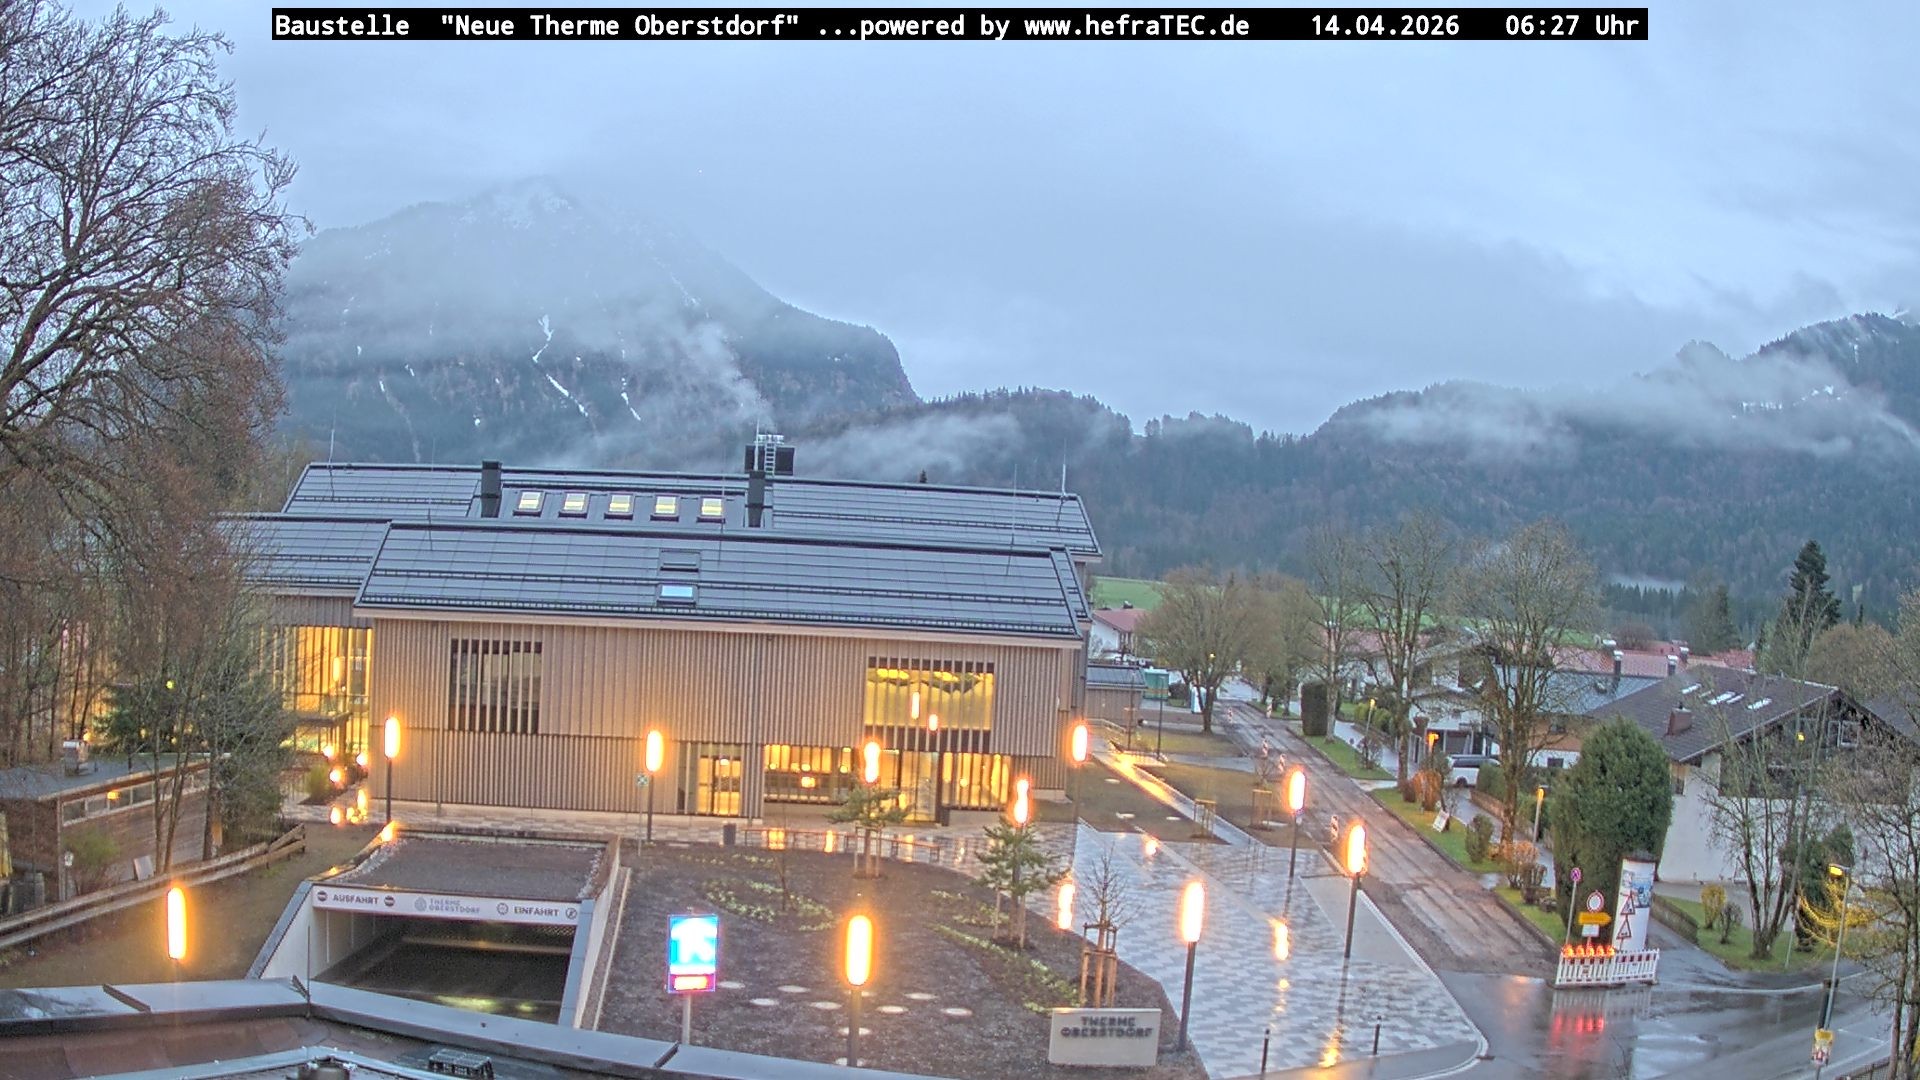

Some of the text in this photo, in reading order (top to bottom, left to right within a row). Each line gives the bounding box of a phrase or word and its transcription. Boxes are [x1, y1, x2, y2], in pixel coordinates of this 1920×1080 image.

[333, 894, 379, 905] AUSFAHRT
[513, 906, 559, 917] EINFAHRT
[1081, 1016, 1136, 1026] THERME
[1060, 1027, 1152, 1038] OBERSTDORF
